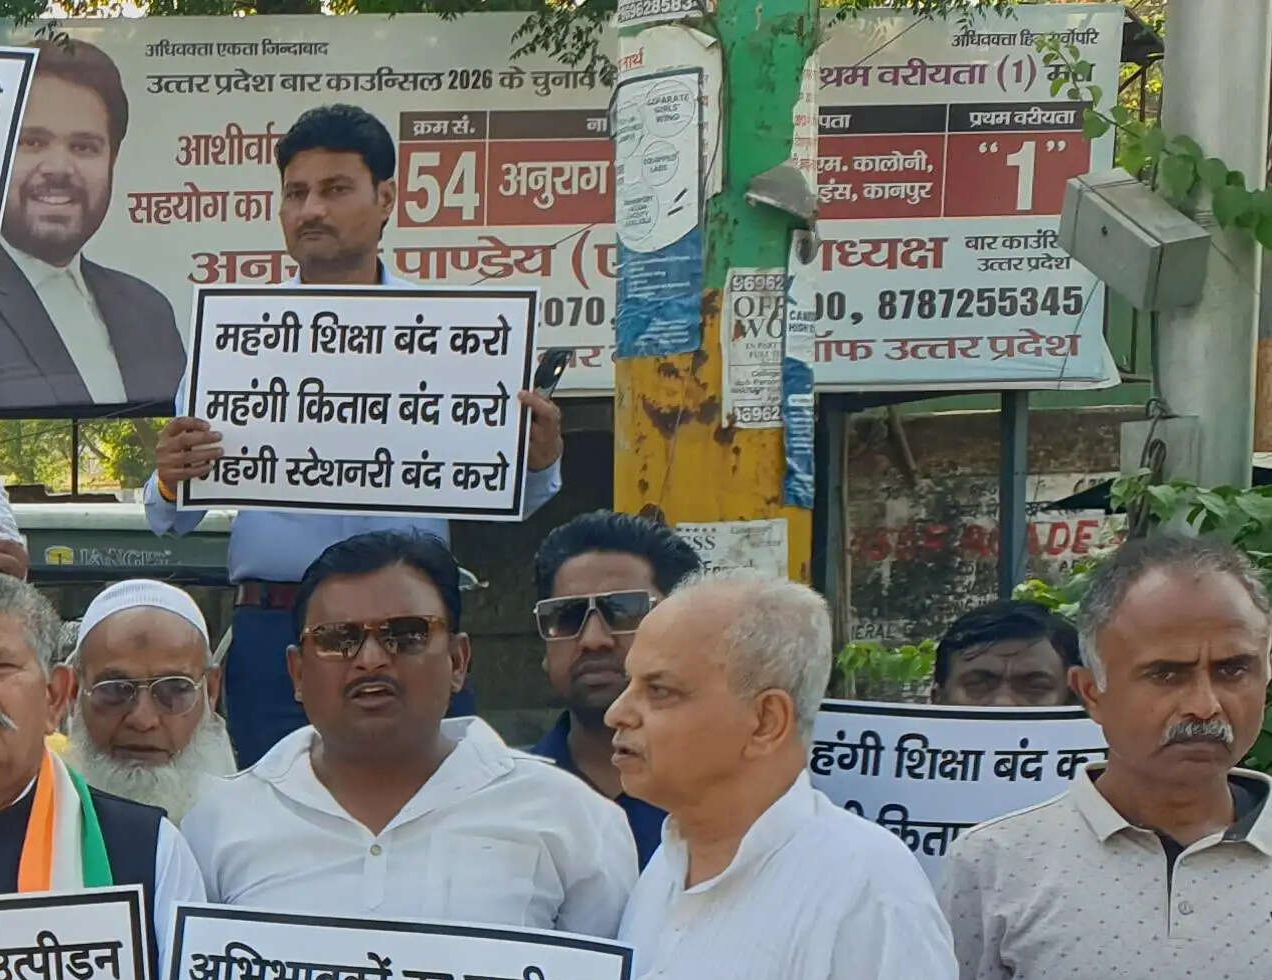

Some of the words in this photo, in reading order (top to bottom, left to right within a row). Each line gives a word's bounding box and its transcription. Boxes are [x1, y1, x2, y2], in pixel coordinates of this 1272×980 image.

[217, 41, 258, 57] एकता
[262, 41, 329, 57] जिन्दाबाद
[146, 73, 210, 95] उत्तर
[216, 71, 275, 94] प्रदेश
[280, 72, 320, 92] बार
[323, 68, 444, 94] काउन्सिल
[448, 69, 492, 90] 2026
[499, 67, 526, 89] के
[878, 57, 988, 87] वरीयता
[997, 54, 1037, 92] (1)
[413, 120, 449, 136] क्रम
[452, 117, 475, 135] सं.
[586, 119, 608, 133] ना
[970, 113, 1011, 127] प्रथम
[1014, 108, 1075, 126] वरीयता
[853, 150, 933, 173] कालोनी,
[405, 151, 479, 223] 54
[500, 161, 607, 209] अनुराग
[862, 182, 933, 205] कानपुर
[128, 182, 227, 224] सहयोग
[235, 189, 273, 223] का
[394, 236, 554, 279] पाण्डेय
[964, 234, 997, 252] बार
[977, 254, 1025, 274] उत्तर
[1028, 253, 1071, 273] प्रदेश
[878, 284, 1083, 321] 8787255345
[215, 310, 303, 356] महंगी
[310, 311, 387, 355] शिक्षा
[394, 313, 442, 355] बंद
[449, 314, 512, 357] करो
[885, 337, 983, 360] उत्तर
[989, 328, 1079, 358] प्रदेश
[206, 376, 291, 427] महंगी
[296, 377, 392, 425] किताब
[398, 380, 445, 426] बंद
[451, 380, 511, 427] करो
[894, 733, 986, 782] शिक्षा
[994, 738, 1048, 782] बंद
